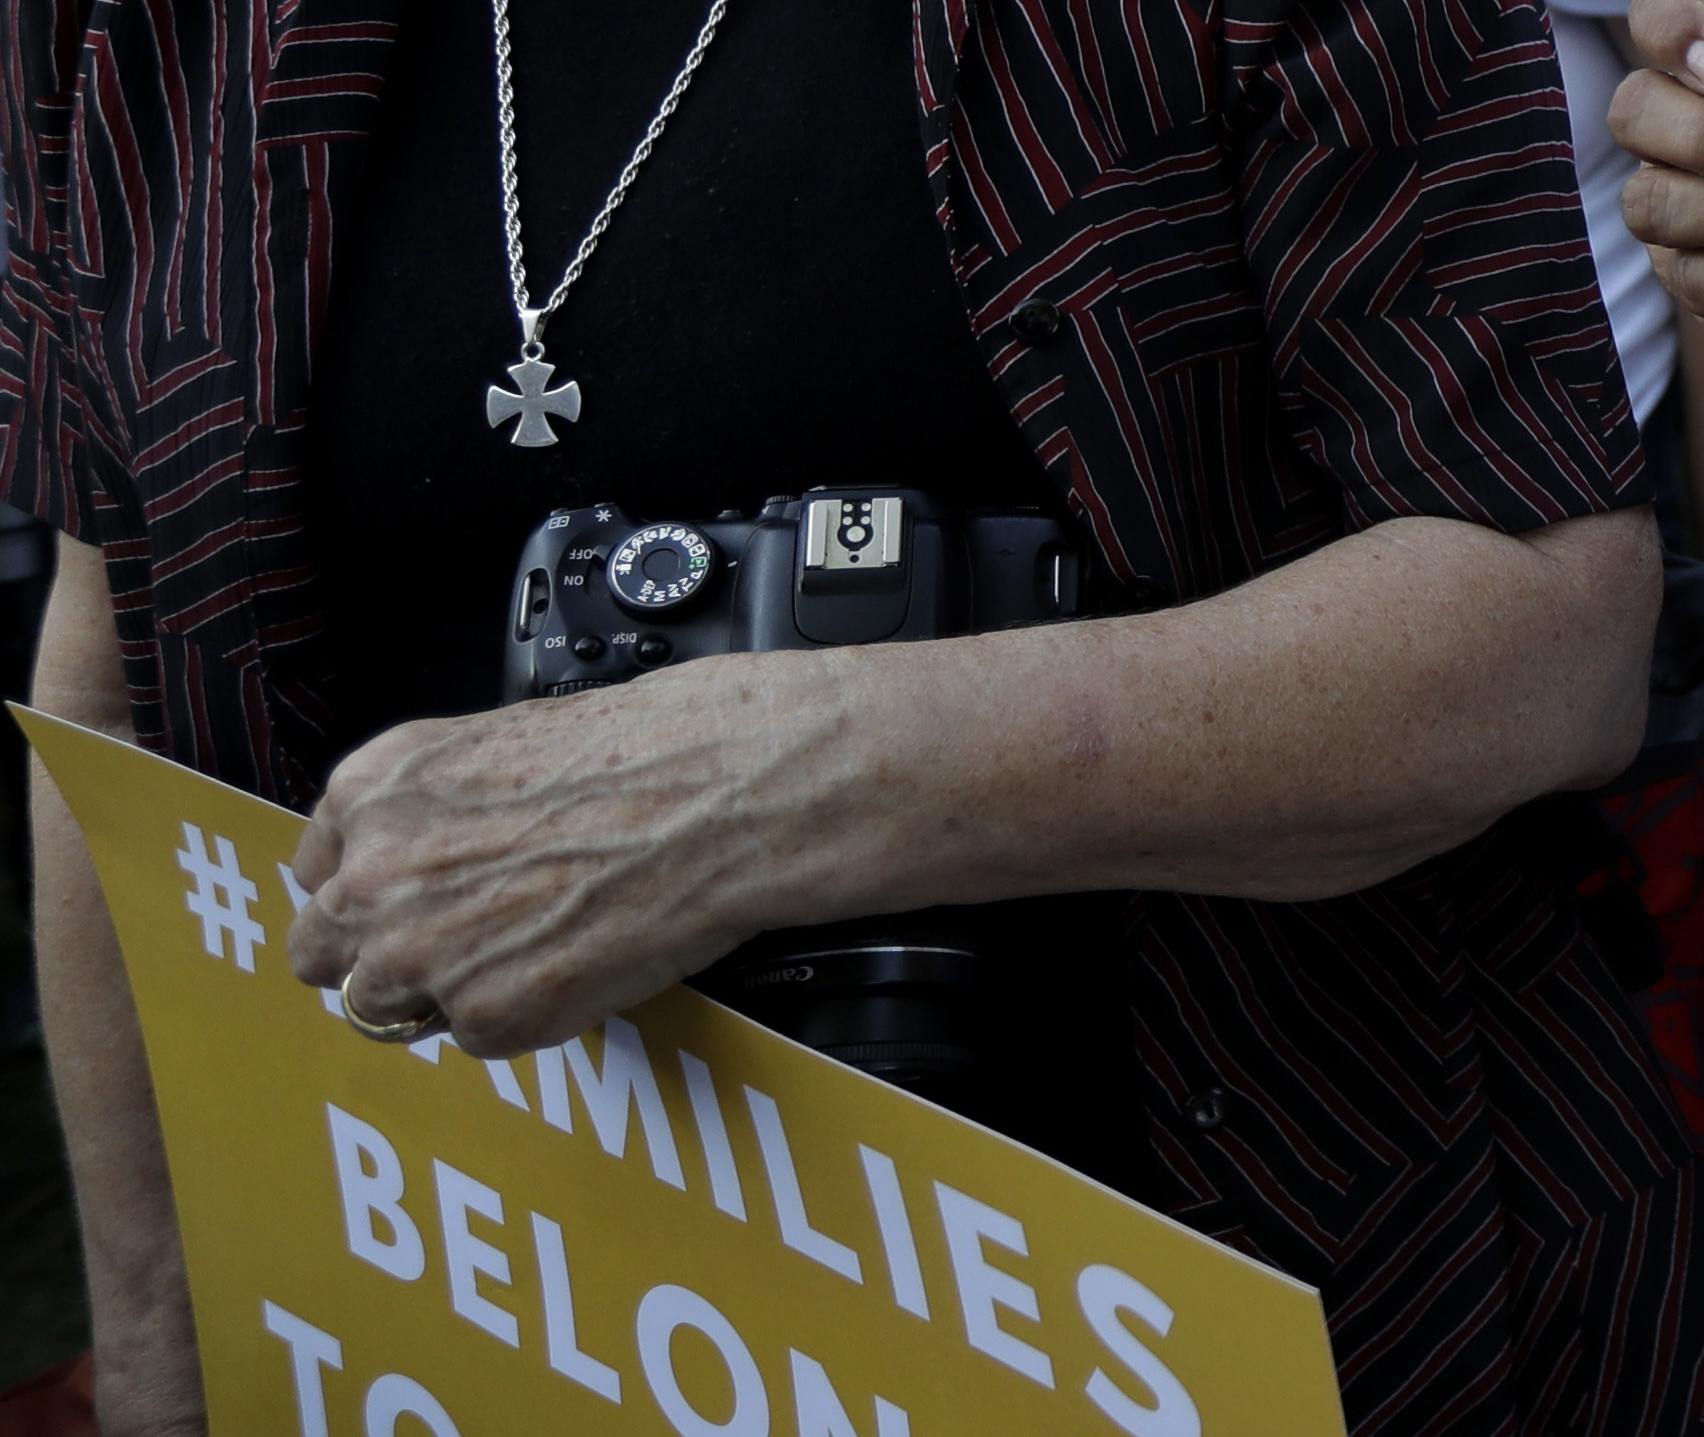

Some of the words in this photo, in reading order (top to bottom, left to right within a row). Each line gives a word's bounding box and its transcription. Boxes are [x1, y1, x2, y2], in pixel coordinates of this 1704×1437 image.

[569, 548, 593, 560] OFF
[563, 575, 584, 586] ON
[544, 636, 566, 649] ISO
[176, 820, 1202, 1437] #MILIES
